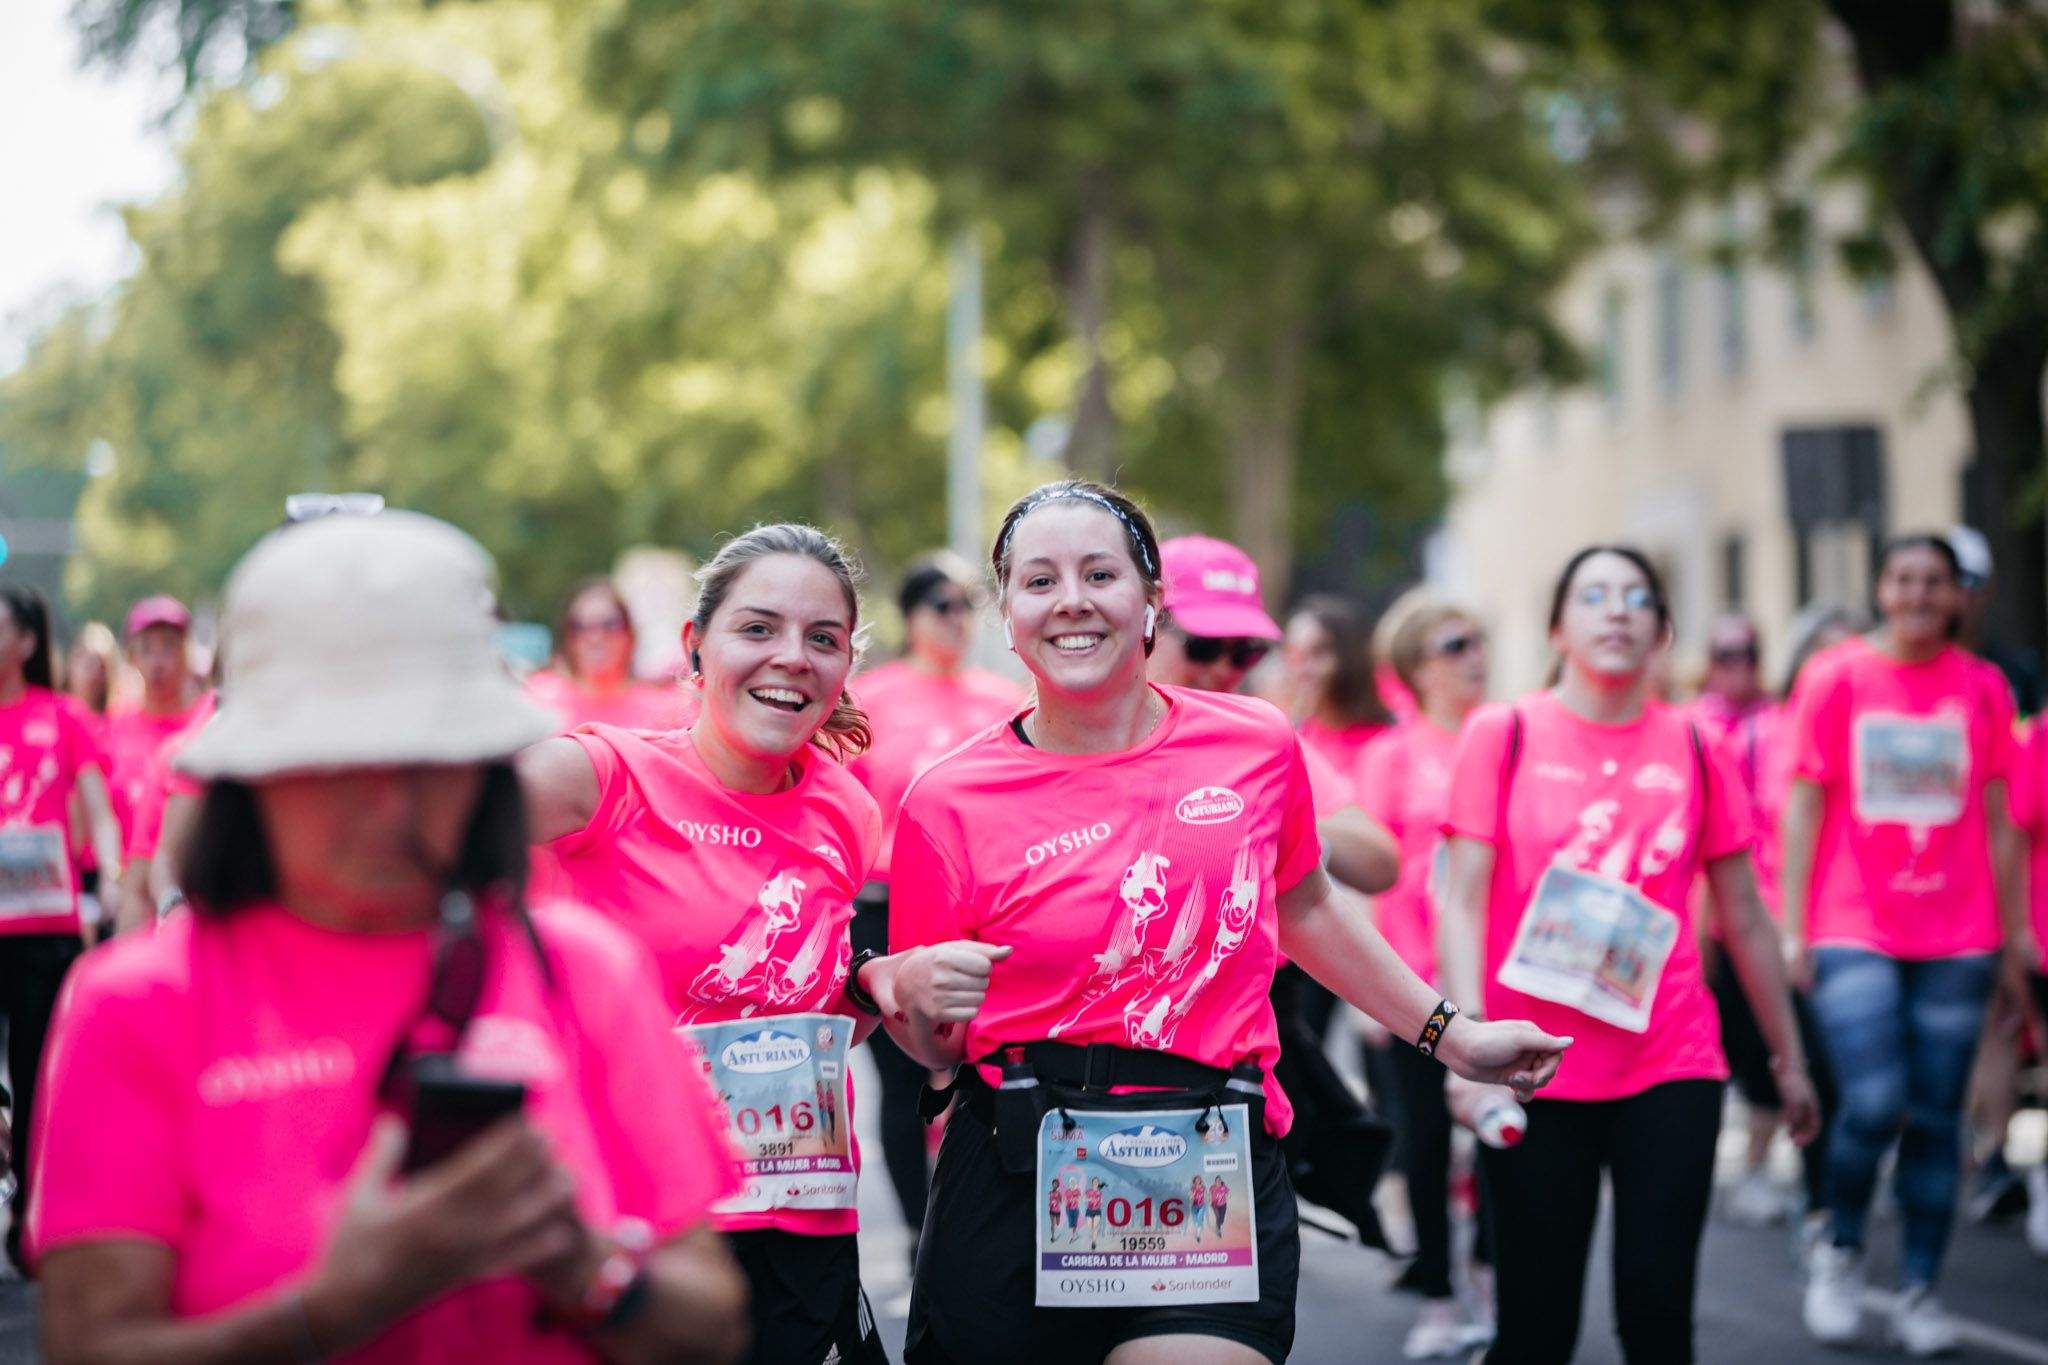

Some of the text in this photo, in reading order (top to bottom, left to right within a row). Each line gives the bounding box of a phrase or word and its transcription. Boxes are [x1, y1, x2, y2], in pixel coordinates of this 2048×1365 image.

[676, 819, 763, 849] OYSHO
[1025, 822, 1111, 865] OYSHO
[727, 1048, 805, 1067] ASTURIANA
[737, 1101, 814, 1135] 016
[759, 1142, 793, 1156] 3891
[1105, 1140, 1181, 1158] ASTURIANA
[744, 1160, 758, 1174] DE
[761, 1160, 775, 1173] LA
[1107, 1197, 1184, 1227] 016
[1120, 1237, 1166, 1251] 19559
[1061, 1252, 1229, 1268] CARRERA DE LA MUJER MADRID
[1060, 1278, 1232, 1294] OYSHO Santander
